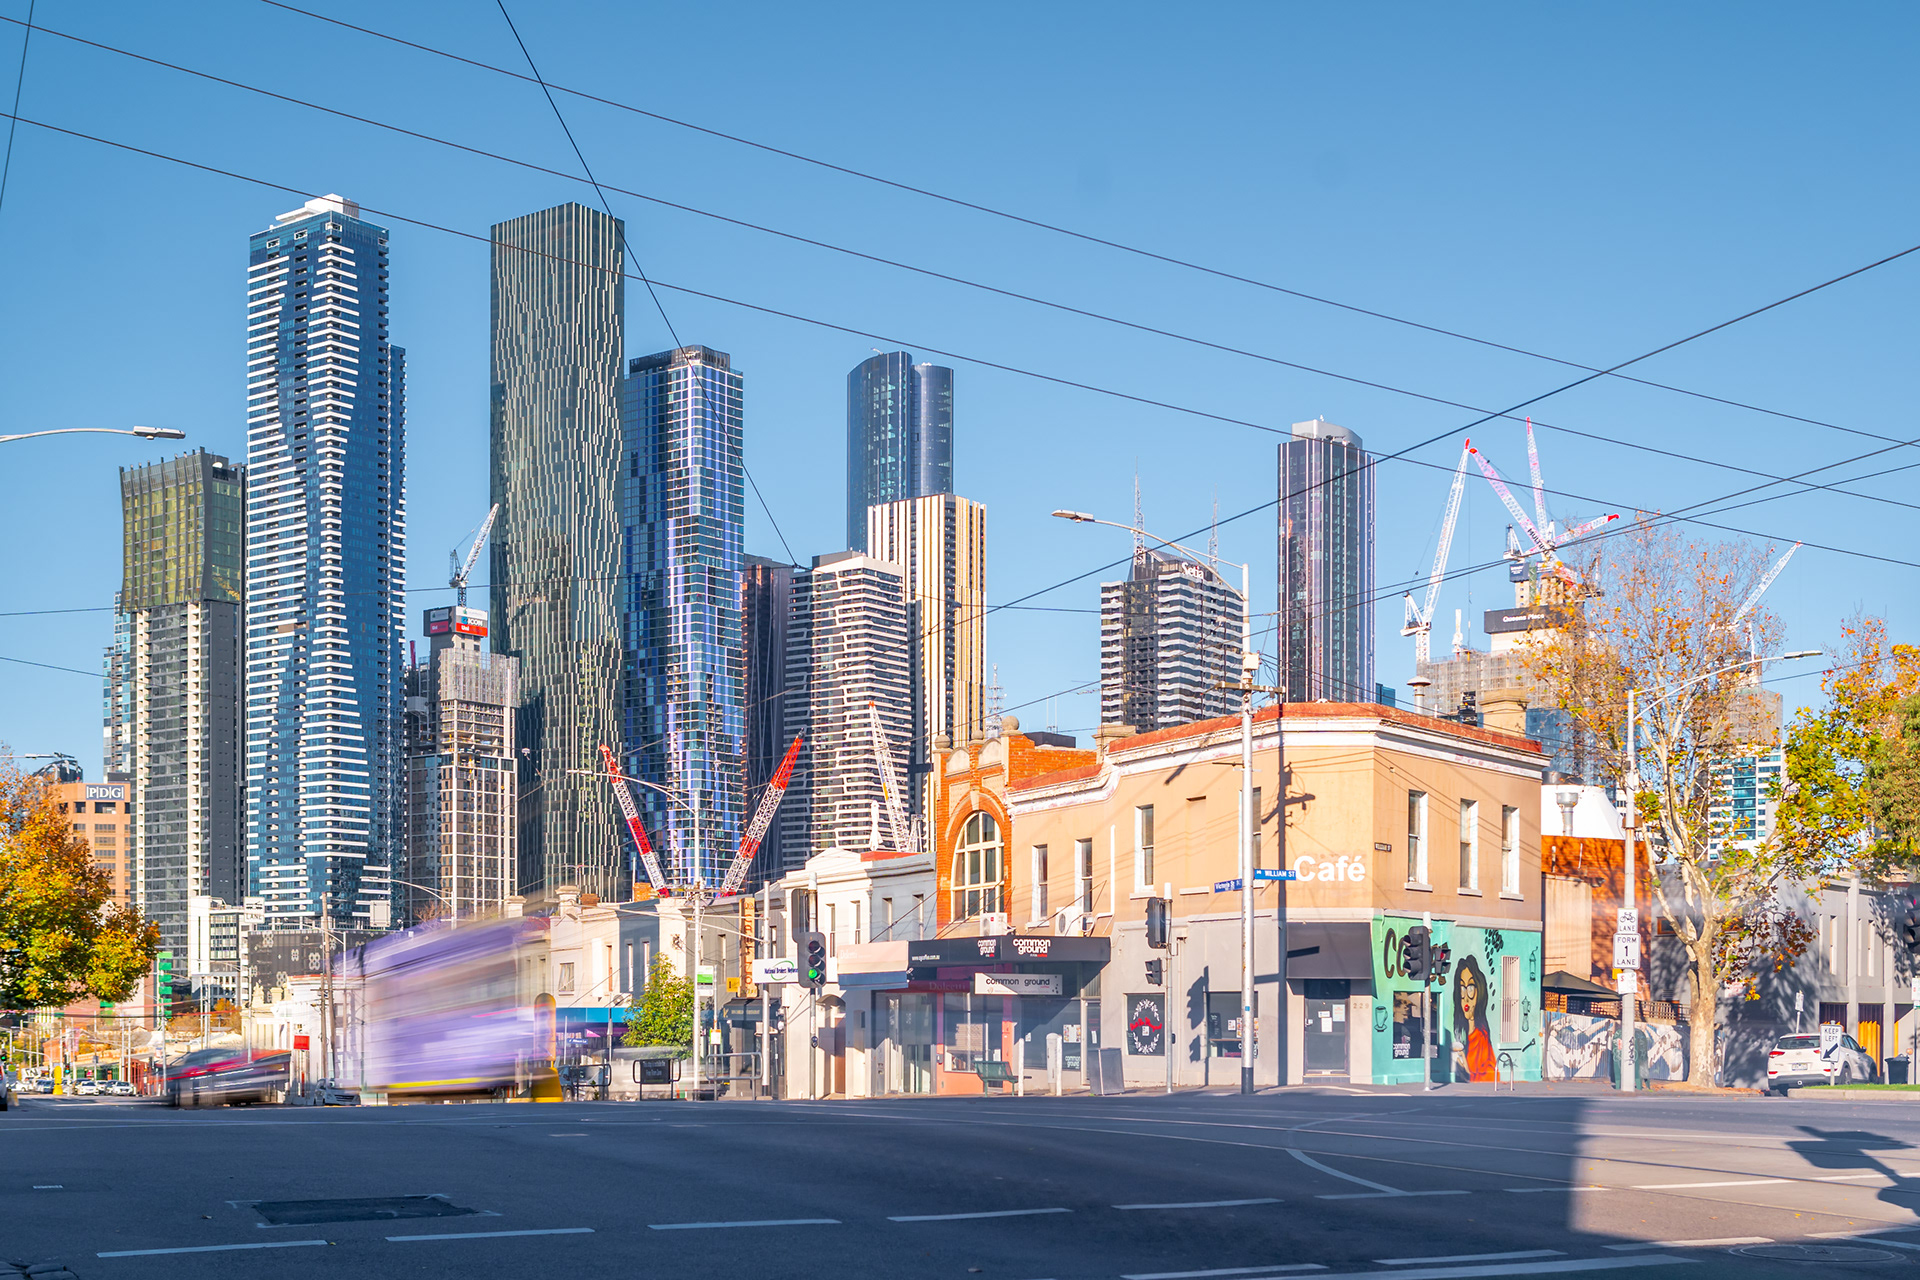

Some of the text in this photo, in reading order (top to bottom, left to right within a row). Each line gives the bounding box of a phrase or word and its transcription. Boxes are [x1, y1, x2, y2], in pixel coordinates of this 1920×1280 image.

[1181, 562, 1204, 580] Setia
[1293, 855, 1366, 882] Café
[977, 939, 996, 947] common
[1013, 939, 1051, 947] common
[980, 946, 995, 956] ground
[1018, 946, 1048, 955] ground
[1624, 945, 1629, 957] 1
[1024, 978, 1050, 986] ground
